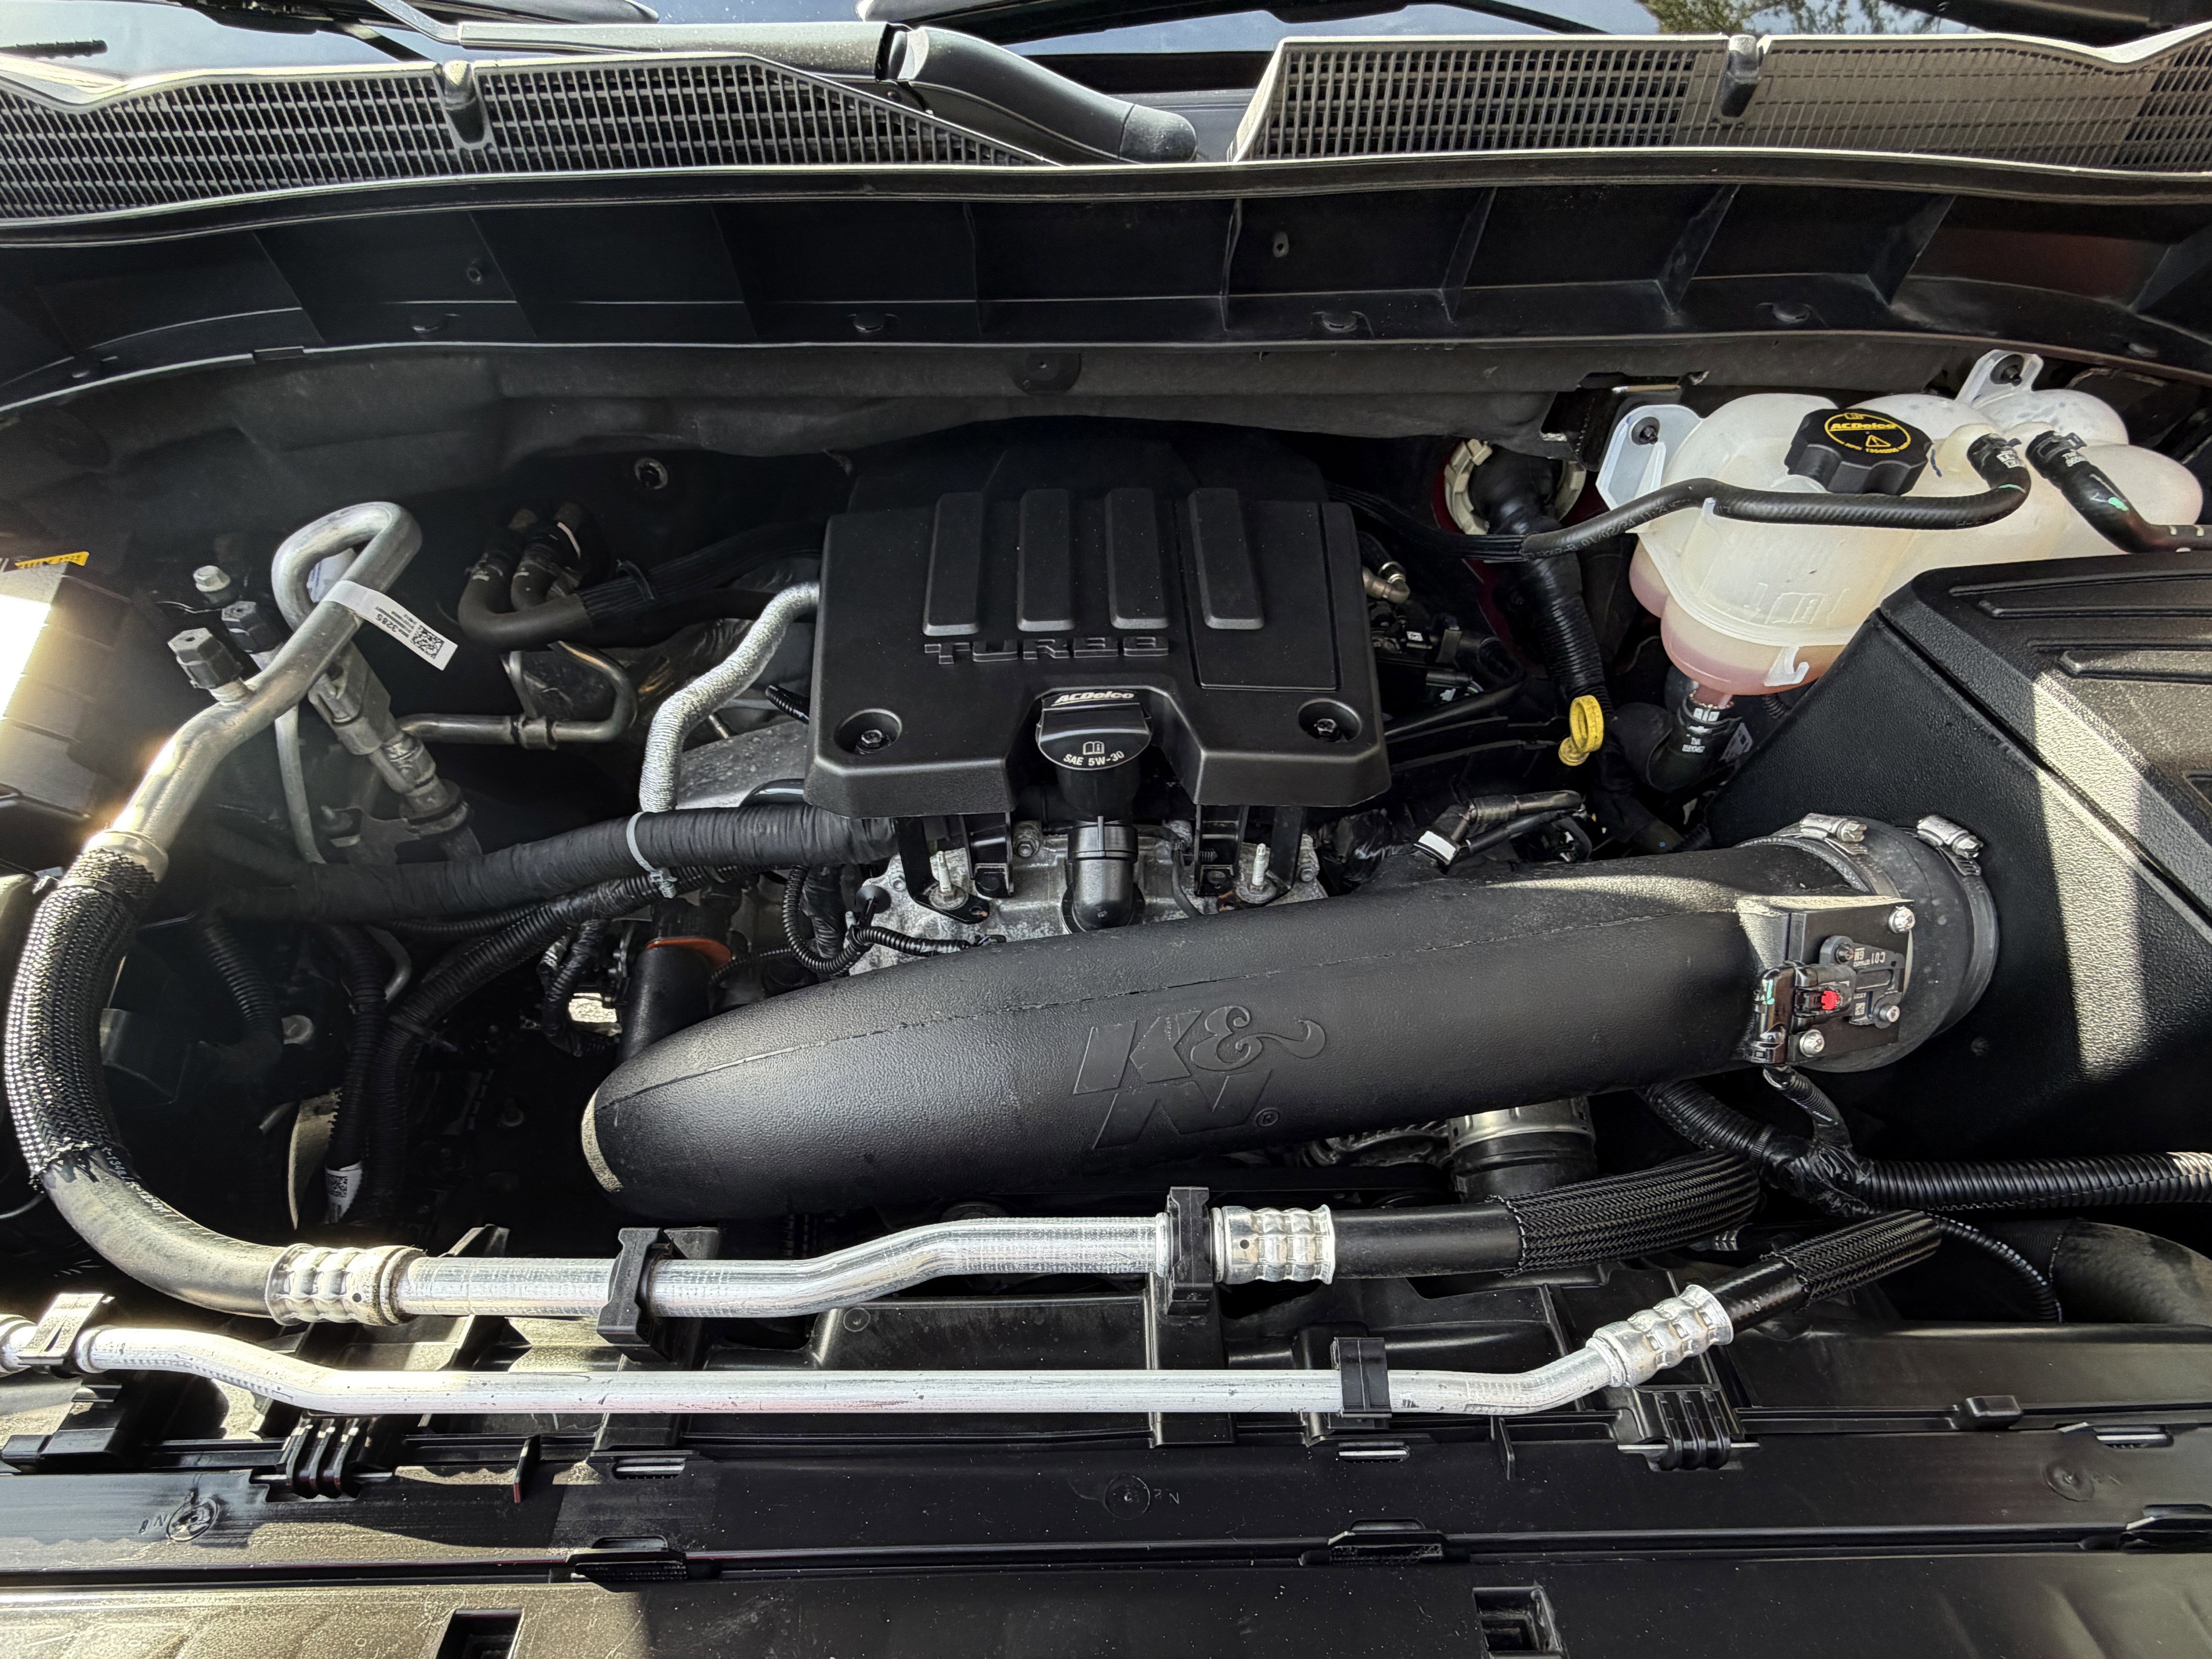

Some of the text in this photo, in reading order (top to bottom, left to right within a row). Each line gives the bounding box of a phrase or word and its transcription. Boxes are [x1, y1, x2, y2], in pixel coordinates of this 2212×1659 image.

[375, 613, 398, 632] 3285
[924, 635, 1169, 664] TURBO
[1053, 691, 1135, 704] ACDelco
[1063, 750, 1125, 766] SAE 5W-30
[1871, 951, 1886, 964] C01
[1072, 1005, 1327, 1150] K&N
